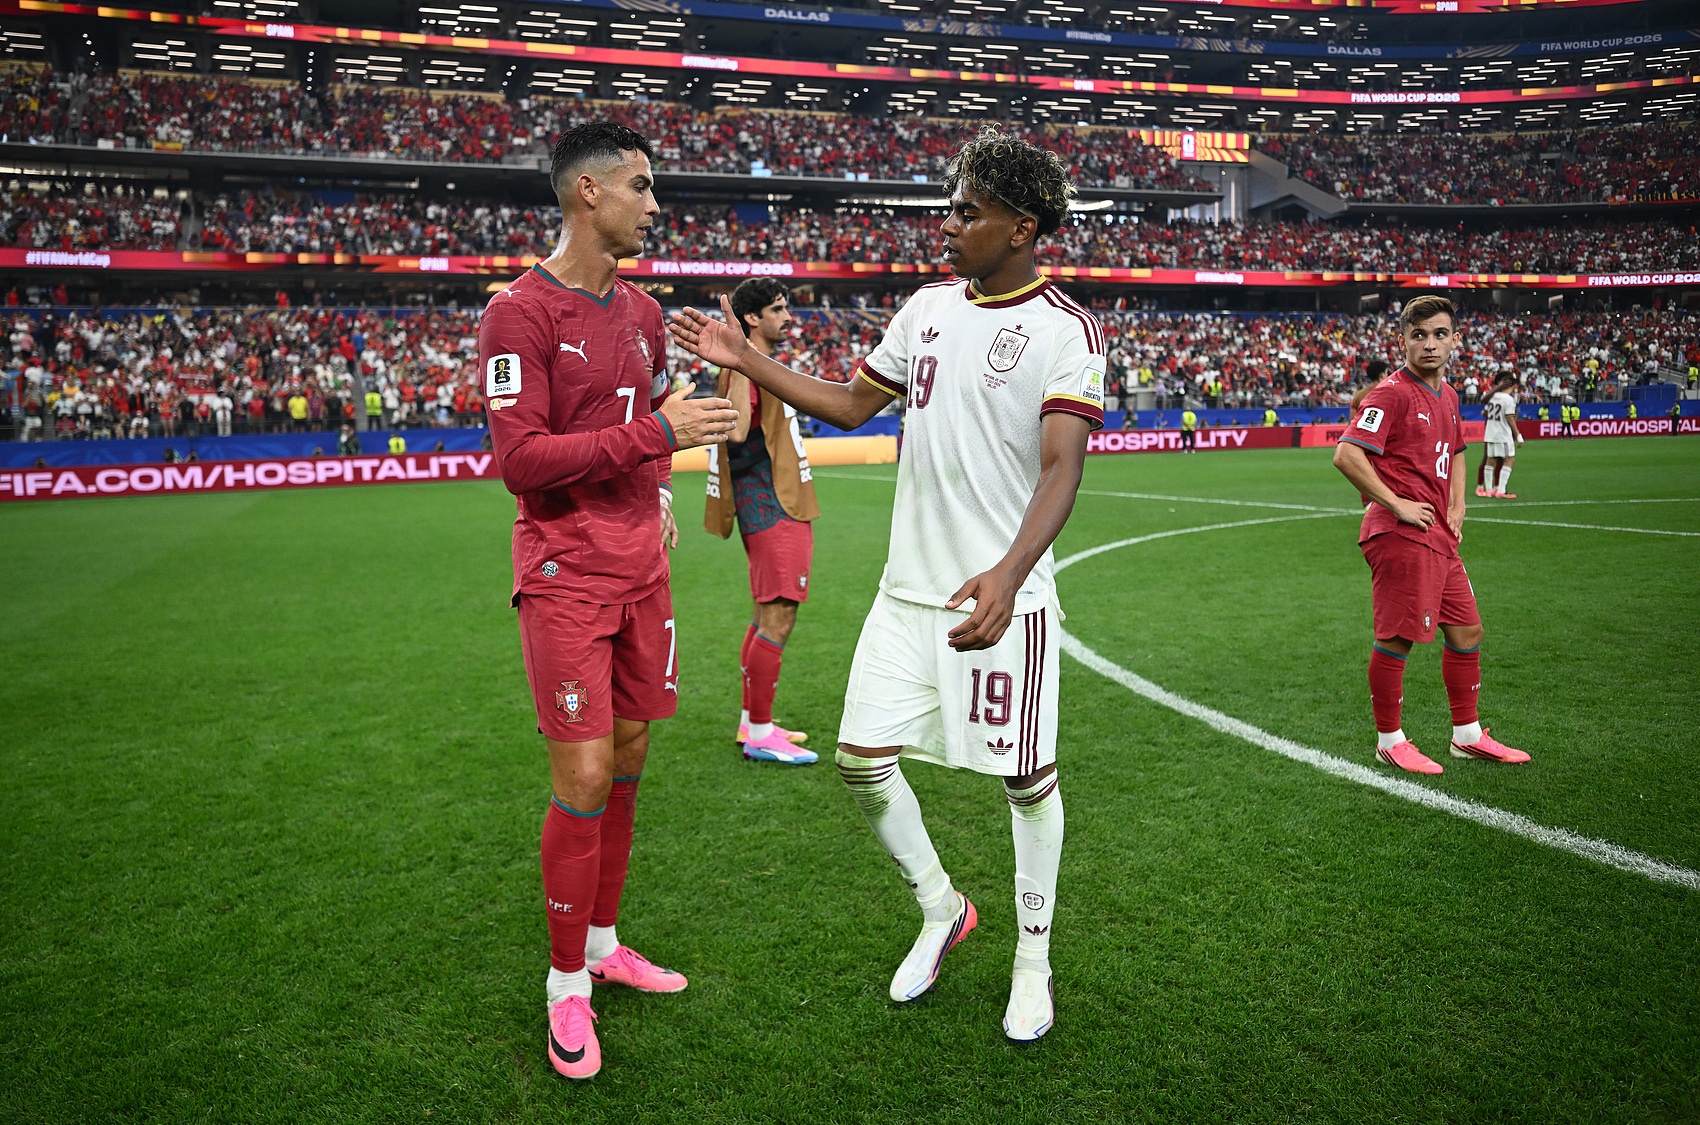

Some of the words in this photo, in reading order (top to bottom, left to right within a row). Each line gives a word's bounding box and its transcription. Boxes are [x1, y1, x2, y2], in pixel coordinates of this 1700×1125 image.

[1436, 1, 1458, 11] SPAIN
[764, 8, 830, 22] DALLAS
[265, 23, 294, 38] SPAIN
[1541, 42, 1562, 51] FIFA
[1563, 40, 1600, 50] WORLD
[1601, 38, 1622, 47] CUP
[1624, 34, 1662, 45] 2026
[1327, 46, 1382, 56] DALLAS
[1351, 93, 1371, 103] FIFA
[1371, 93, 1406, 103] WORLD
[1407, 93, 1426, 103] CUP
[1426, 92, 1460, 103] 2026
[25, 250, 110, 268] #FIFAWorldCup
[419, 257, 449, 271] SPAIN
[652, 261, 680, 274] FIFA
[680, 261, 725, 275] WORLD
[725, 262, 750, 275] CUP
[750, 262, 794, 276] 2026
[1588, 275, 1612, 286] FIFA
[1611, 275, 1651, 285] WORLD
[1651, 274, 1674, 284] CUP
[907, 354, 938, 409] 19
[615, 386, 636, 425] 7
[1487, 402, 1502, 422] 22
[664, 618, 677, 677] 7
[968, 667, 1014, 727] 19
